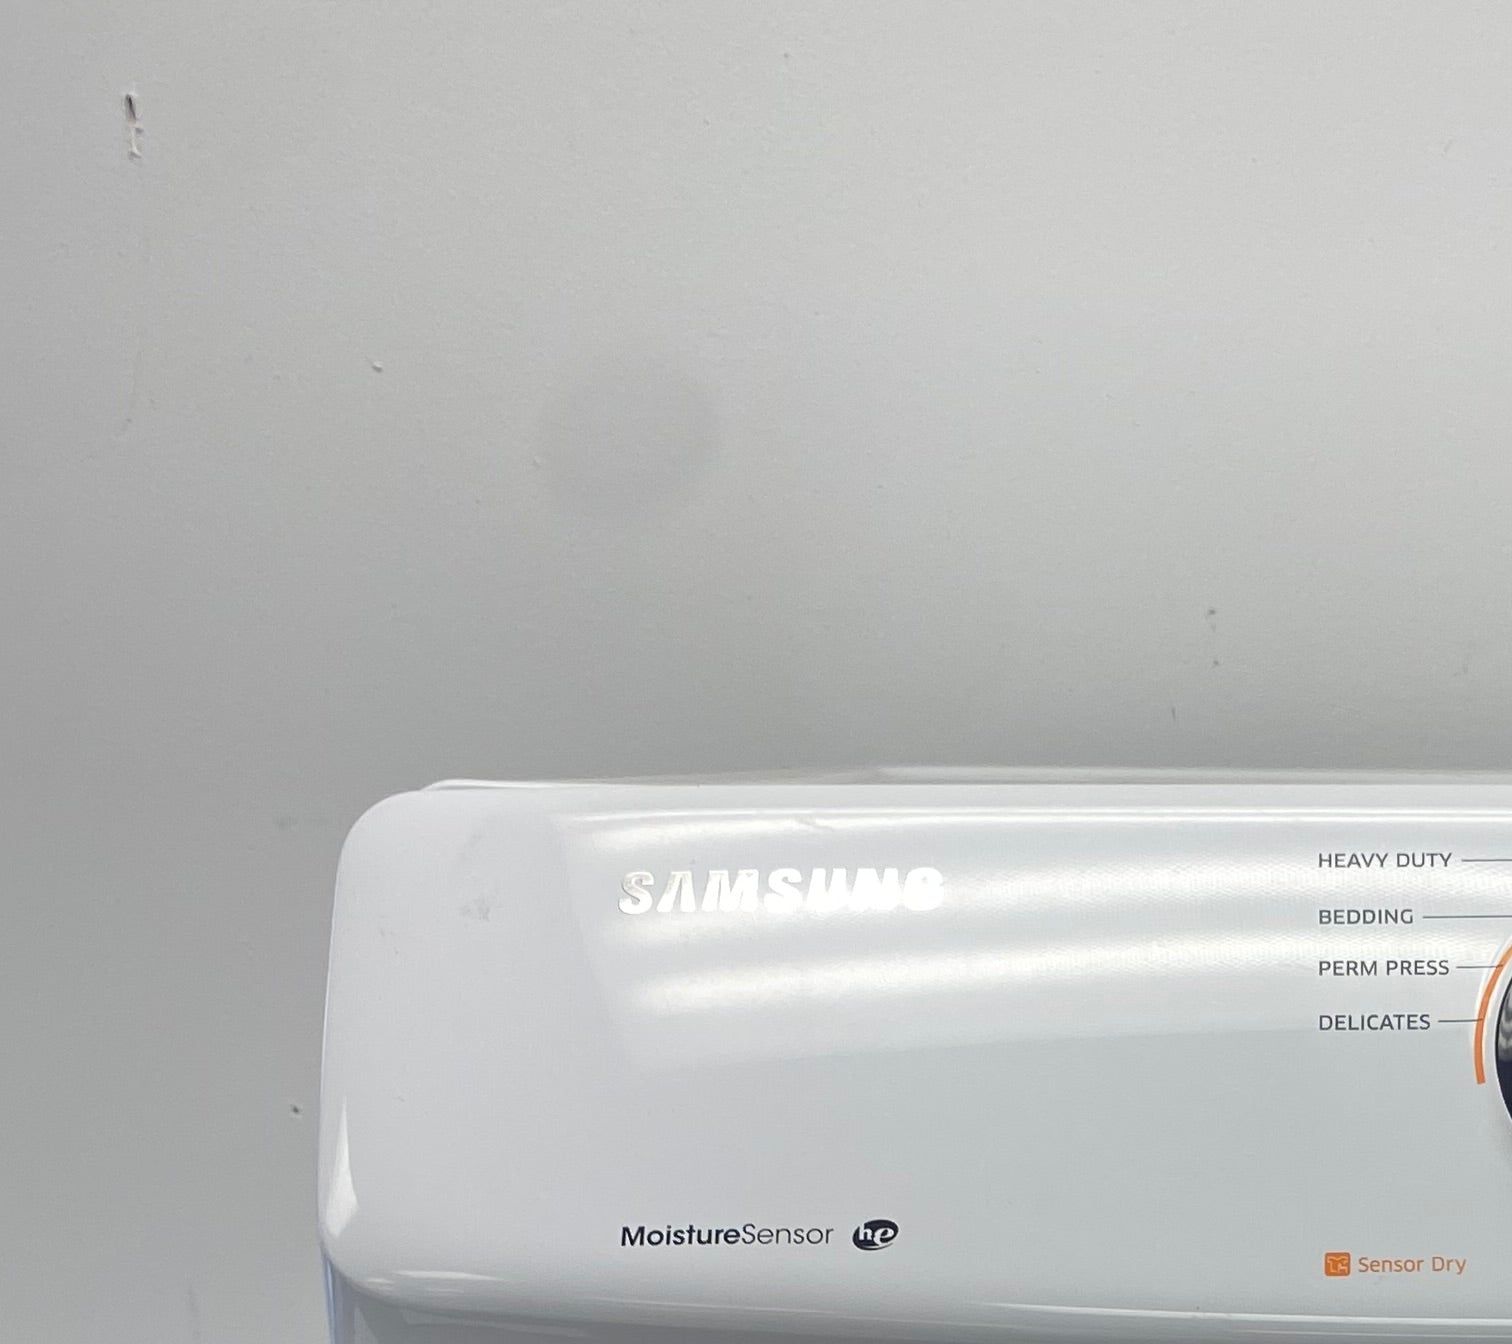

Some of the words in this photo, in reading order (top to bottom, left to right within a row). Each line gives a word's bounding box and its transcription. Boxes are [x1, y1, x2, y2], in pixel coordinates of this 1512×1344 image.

[1318, 852, 1388, 868] HEAVY
[1396, 852, 1453, 867] DUTY
[618, 867, 945, 915] SAMSUNG
[1318, 908, 1414, 925] BEDDING
[1318, 960, 1378, 977] PERM
[1386, 960, 1450, 976] PRESS
[1318, 1013, 1431, 1031] DELICATES
[620, 1224, 834, 1247] MoistureSensor
[1358, 1256, 1424, 1273] Sensor
[1432, 1256, 1467, 1275] Dry
